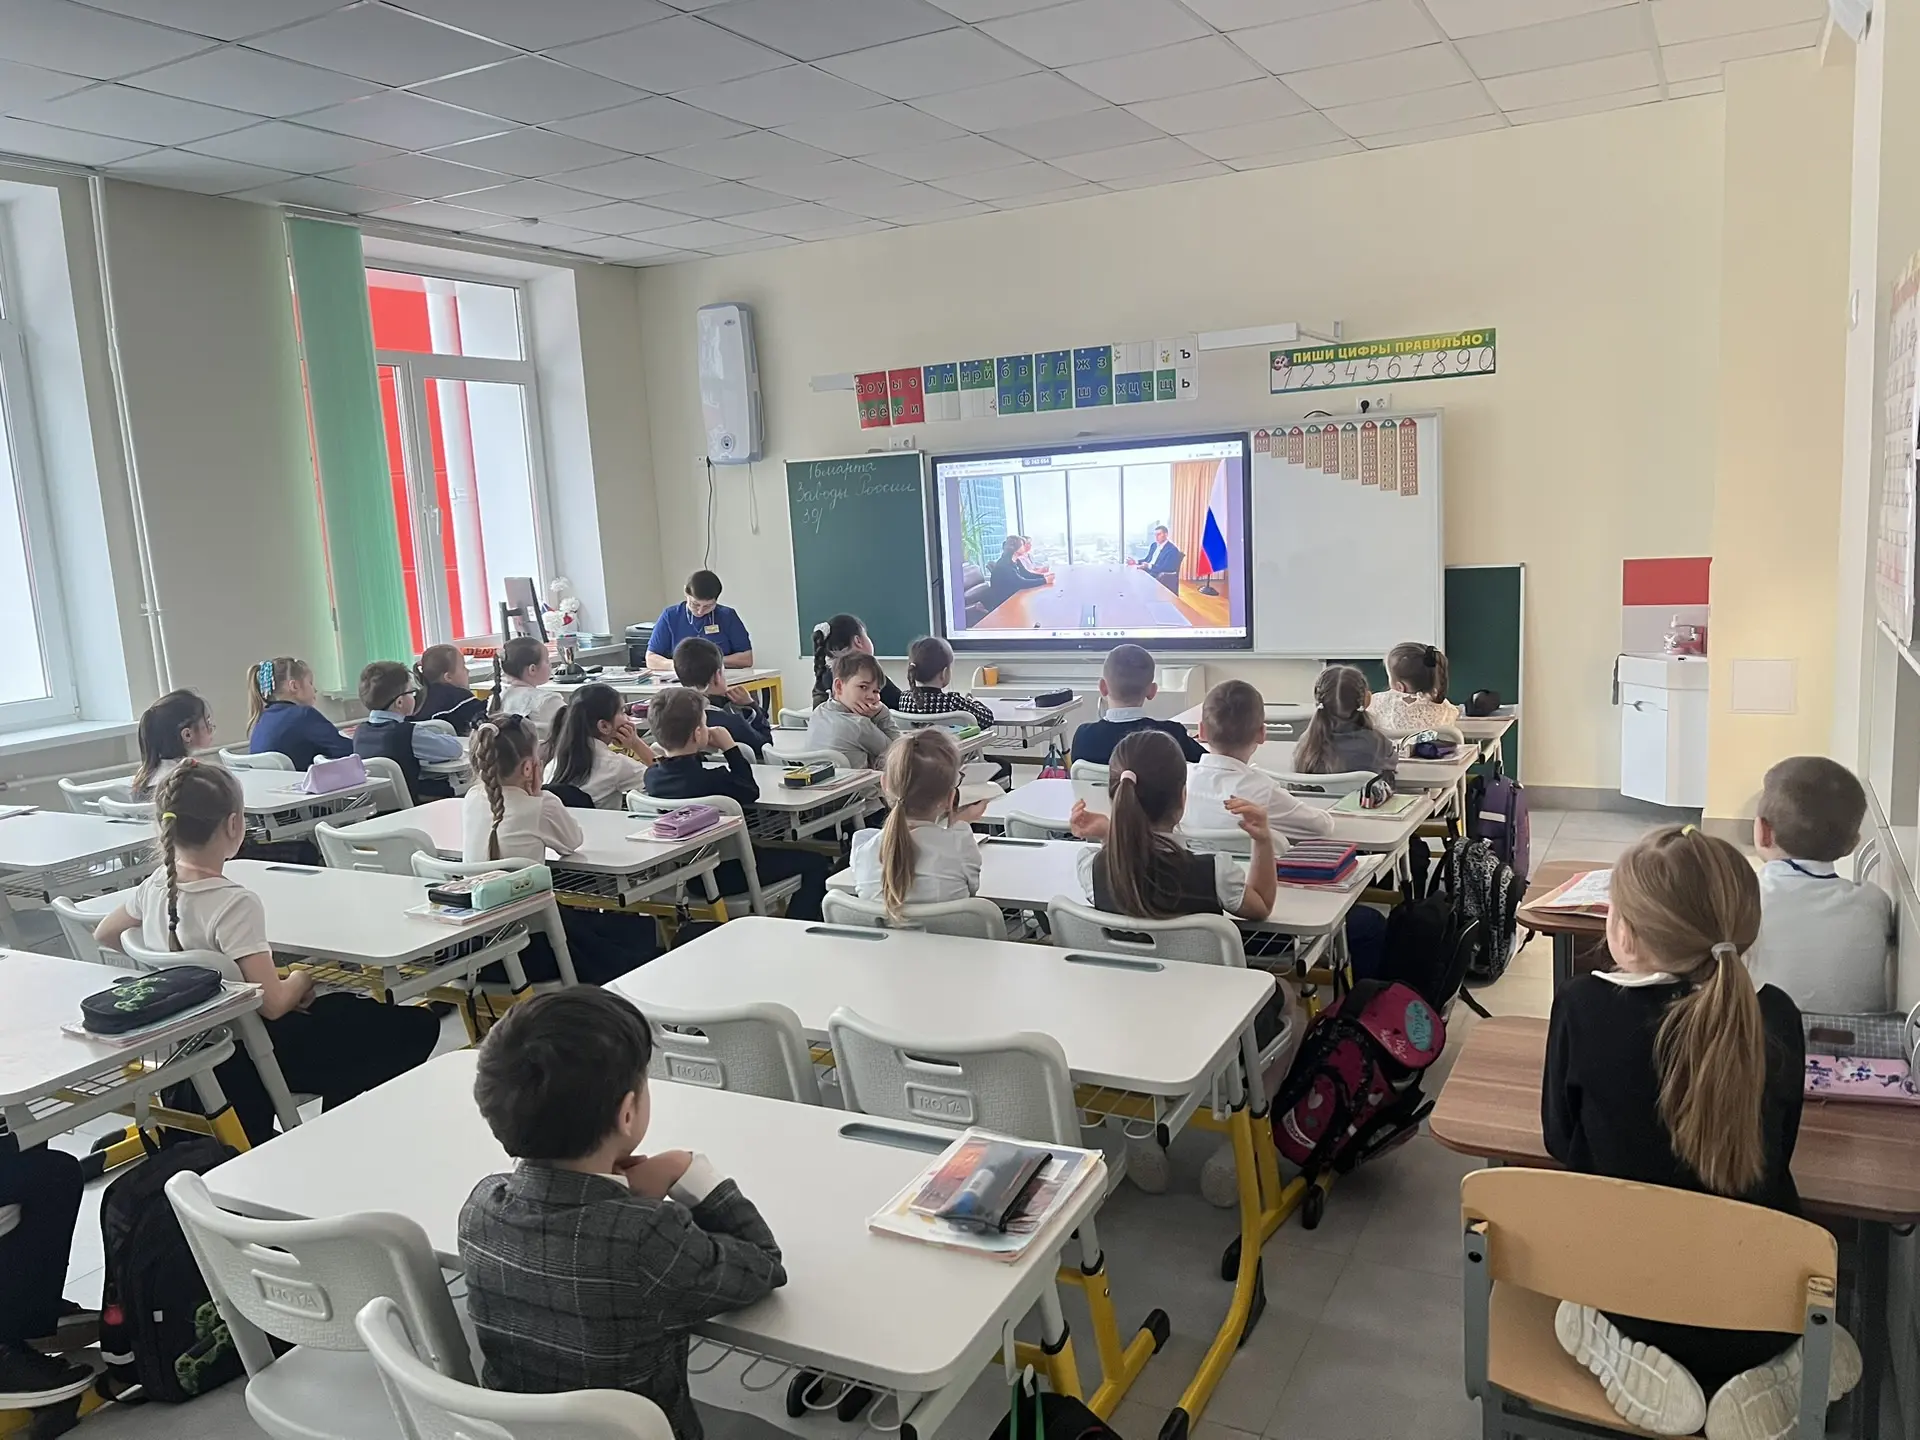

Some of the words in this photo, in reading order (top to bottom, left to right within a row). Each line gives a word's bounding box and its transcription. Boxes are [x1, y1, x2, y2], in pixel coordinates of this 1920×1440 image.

[1284, 366, 1293, 390] 1
[1301, 363, 1314, 388] 2
[1322, 362, 1336, 385] 3
[1345, 360, 1357, 382] 4
[1366, 357, 1379, 381] 5
[1388, 355, 1401, 379] 6
[1410, 353, 1424, 378] 7
[1432, 350, 1447, 375] 8
[1456, 348, 1470, 373] 9
[1479, 346, 1494, 371] 0
[1293, 349, 1334, 363] ПИШИ
[1338, 344, 1391, 360] ЦИФРЫ
[797, 481, 849, 510] Заводы
[855, 473, 916, 496] России
